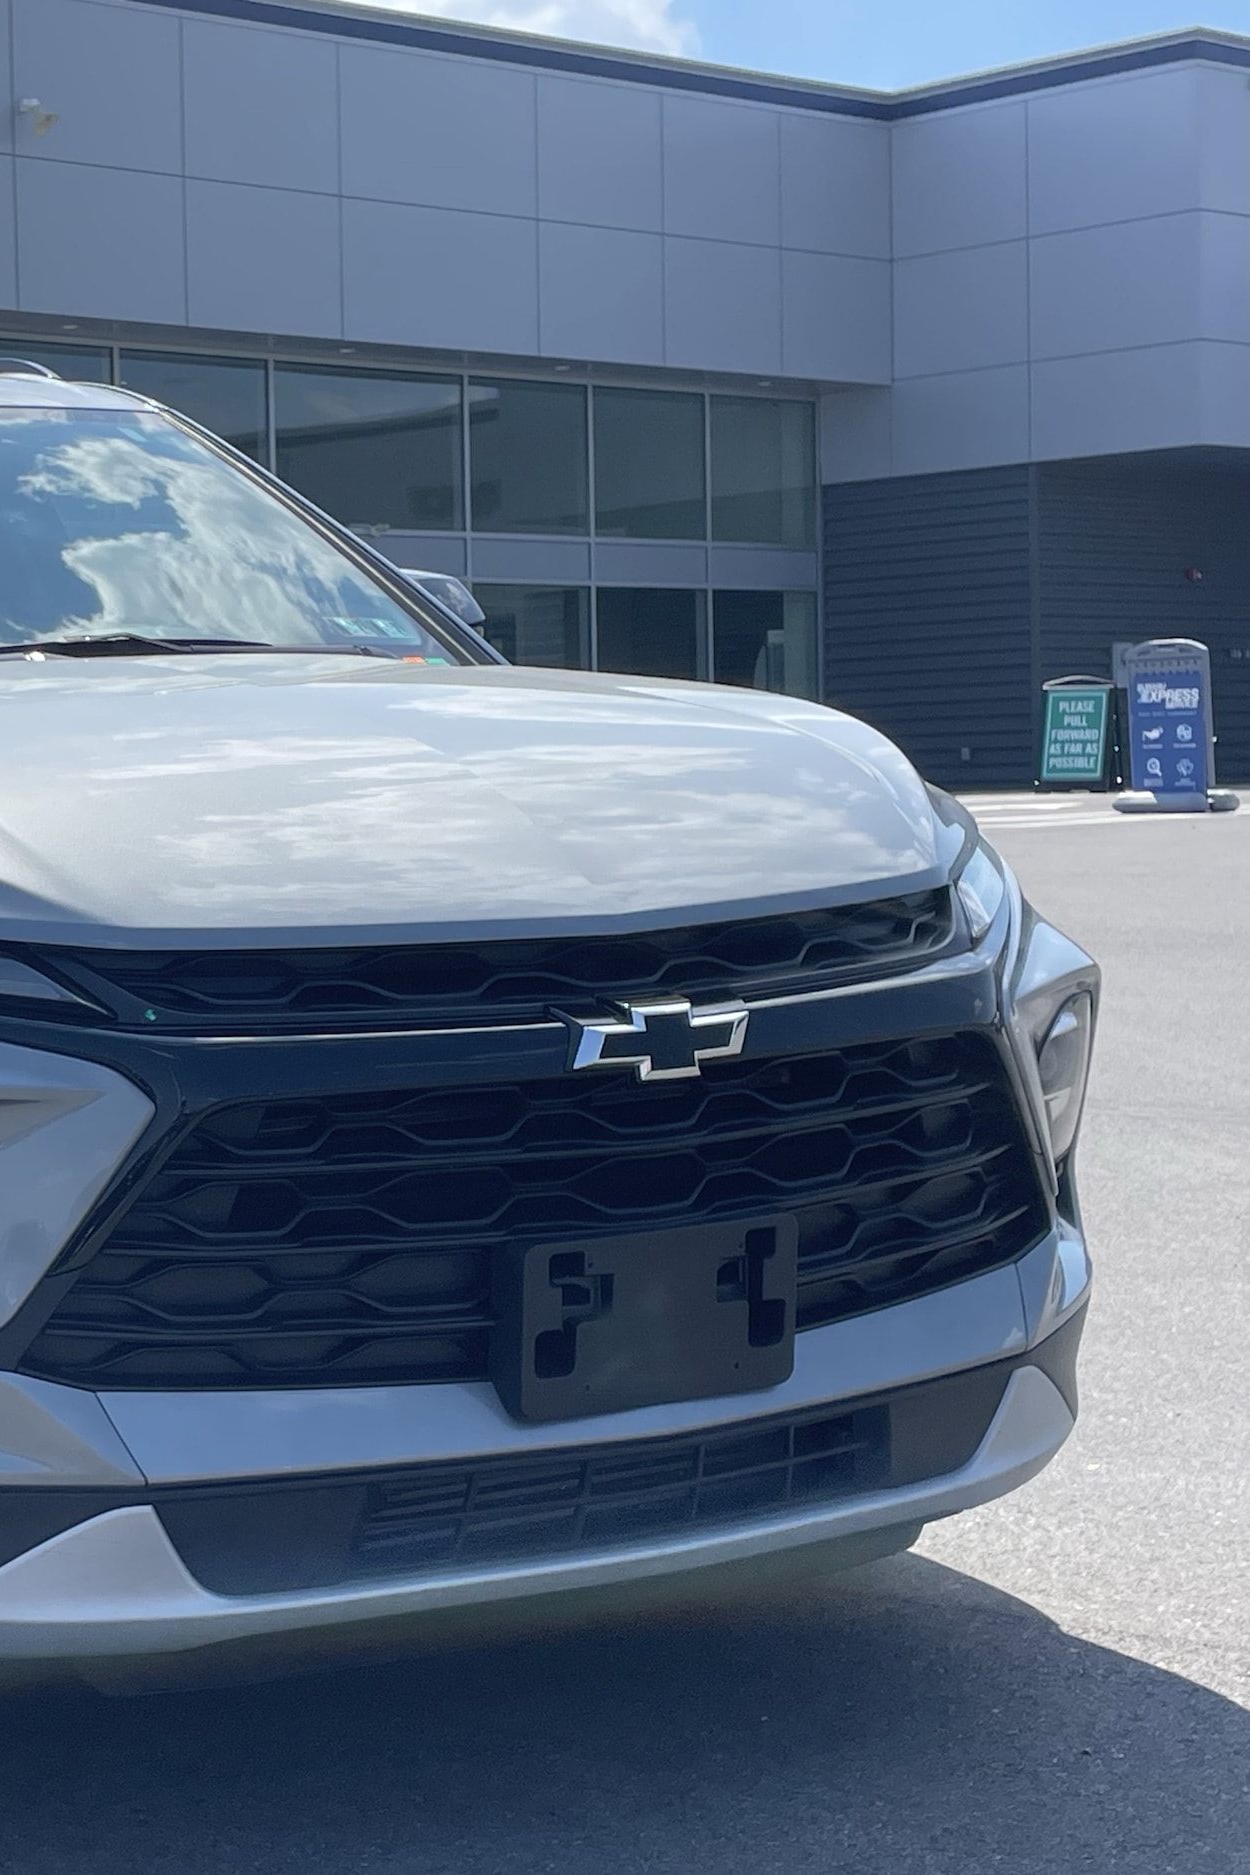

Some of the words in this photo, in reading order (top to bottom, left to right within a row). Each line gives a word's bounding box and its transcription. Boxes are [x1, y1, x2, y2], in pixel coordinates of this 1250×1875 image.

[1058, 700, 1096, 713] PLEASE
[1063, 714, 1088, 727] PULL
[1050, 729, 1099, 742] FORWARD
[1049, 742, 1061, 755] AS
[1064, 742, 1083, 755] FAR
[1085, 742, 1098, 754] AS
[1049, 756, 1096, 769] POSSIBLE
